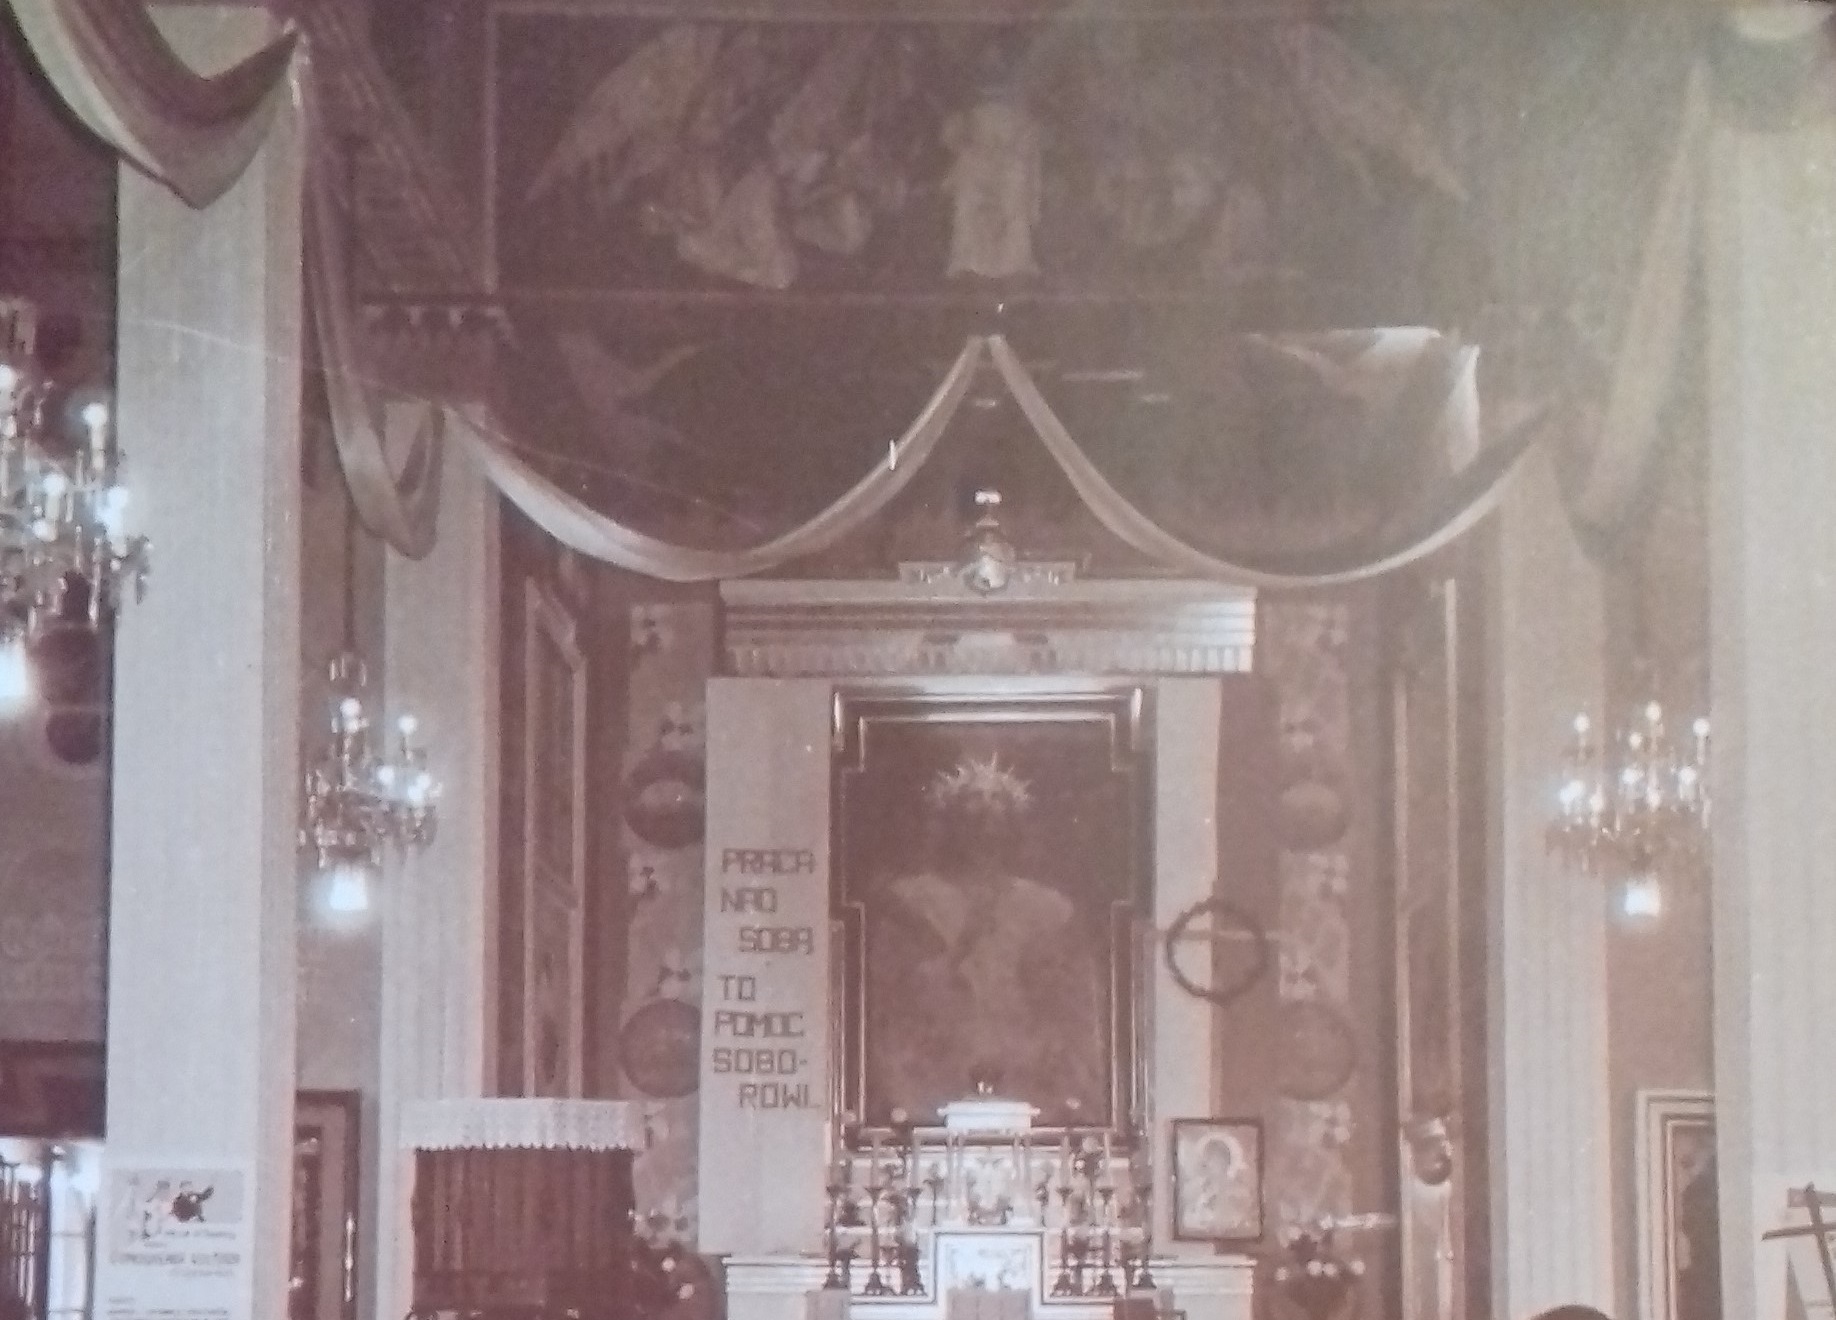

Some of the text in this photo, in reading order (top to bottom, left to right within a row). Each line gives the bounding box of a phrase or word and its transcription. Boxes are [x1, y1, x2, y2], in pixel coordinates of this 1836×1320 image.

[721, 848, 815, 874] PRACA
[718, 974, 756, 1001] TO
[715, 1011, 803, 1037] POMOC
